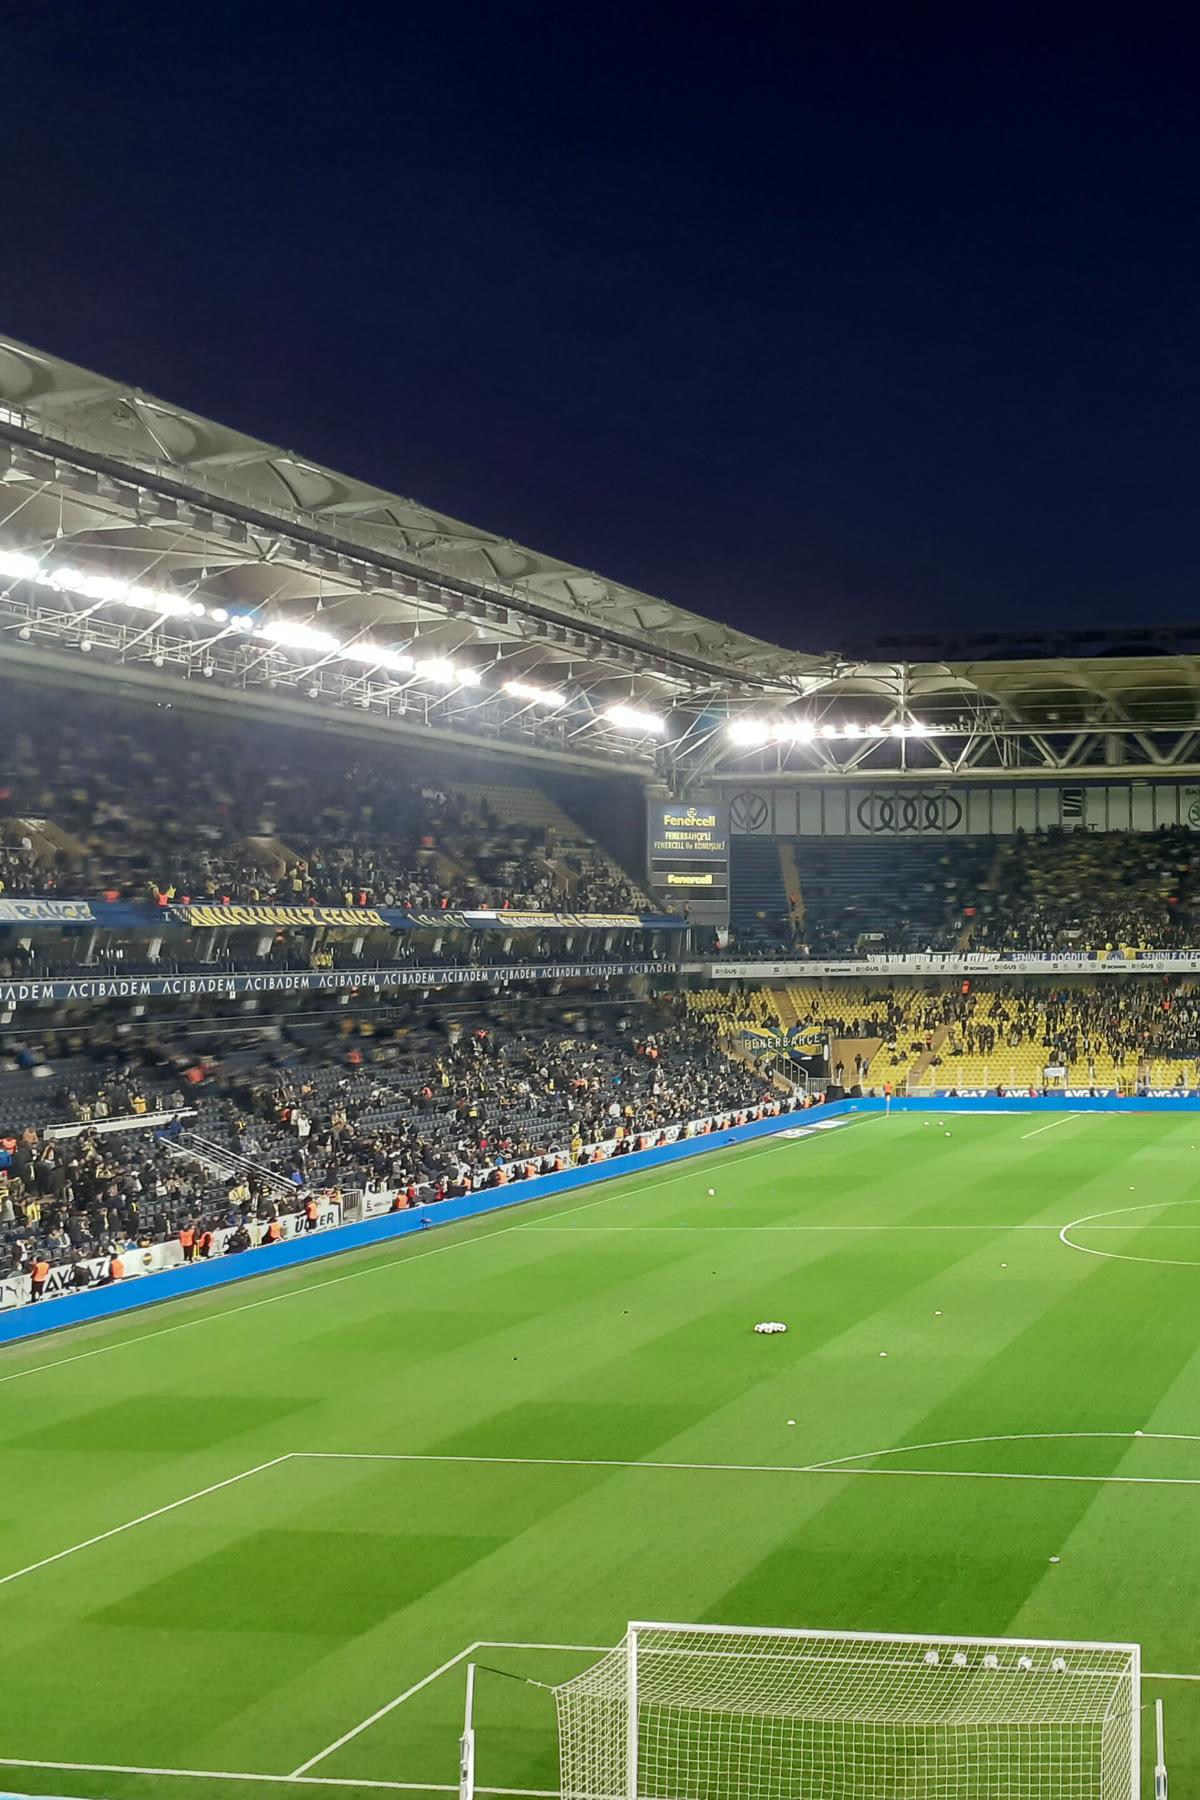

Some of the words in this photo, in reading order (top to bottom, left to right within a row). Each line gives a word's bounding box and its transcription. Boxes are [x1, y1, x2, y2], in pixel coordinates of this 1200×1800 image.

[664, 814, 716, 827] Fenercell
[667, 874, 713, 885] Fenercell
[320, 909, 391, 927] FENER
[67, 982, 151, 997] ACIBADEM
[162, 979, 236, 994] ACIBADEM
[245, 976, 310, 991] ACIBADEM
[319, 974, 376, 988] ACIBADEM
[383, 972, 435, 985] ACIBADEM
[441, 970, 488, 983] ACIBADEM
[493, 968, 537, 980] ACIBADEM
[541, 967, 581, 978] ACIBADEM
[585, 966, 624, 976] ACIBADEM
[295, 1213, 334, 1233] ÜER
